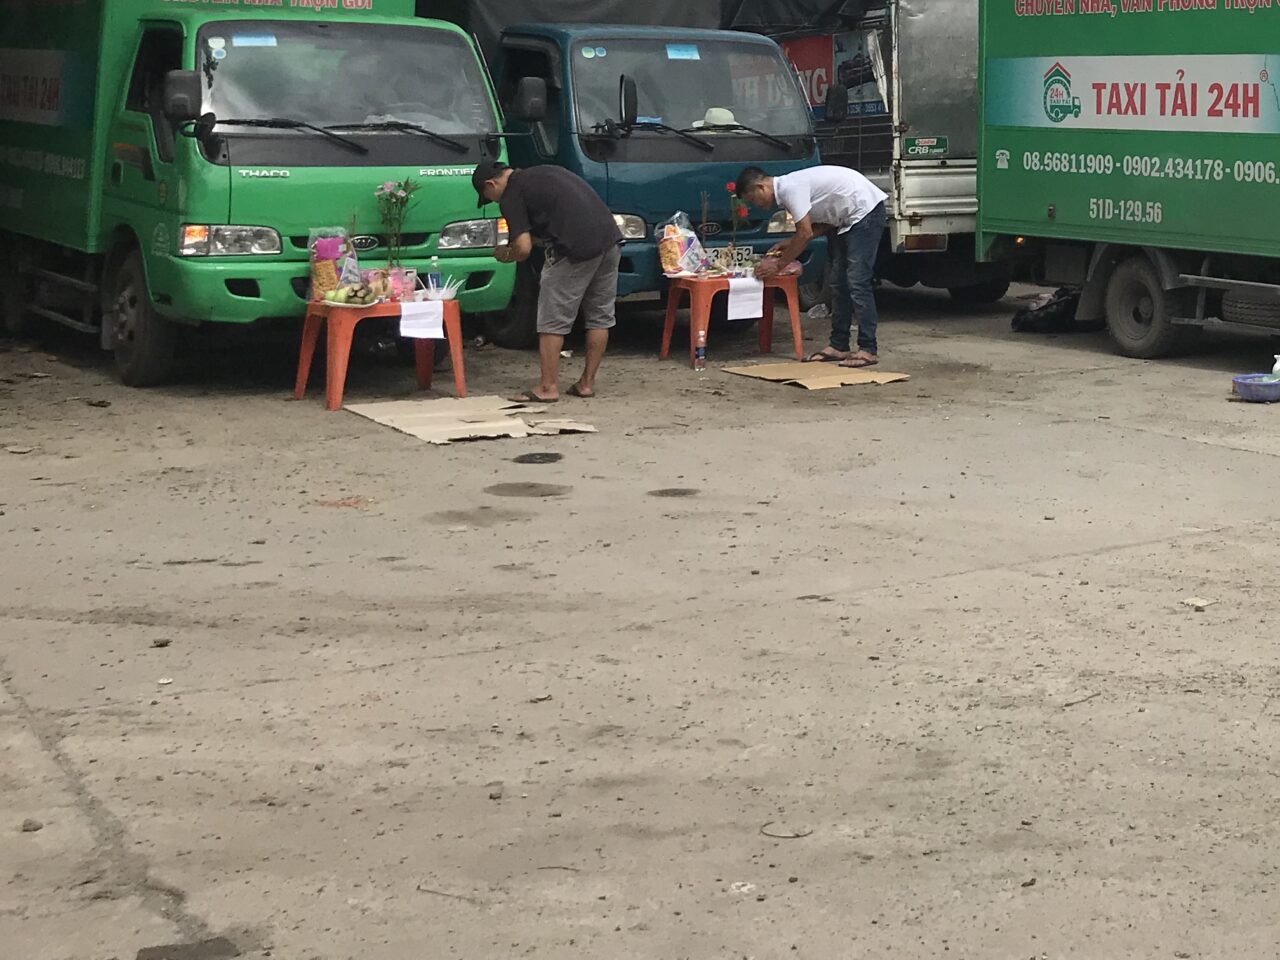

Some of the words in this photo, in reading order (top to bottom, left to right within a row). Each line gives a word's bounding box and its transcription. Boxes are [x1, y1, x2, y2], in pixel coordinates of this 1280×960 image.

[1092, 83, 1146, 115] TAXI
[1156, 69, 1198, 116] TẢI
[1207, 83, 1260, 118] 24H
[238, 170, 290, 178] THACO
[1123, 155, 1223, 180] 0902.434178
[1090, 198, 1162, 224] 51D-129.56
